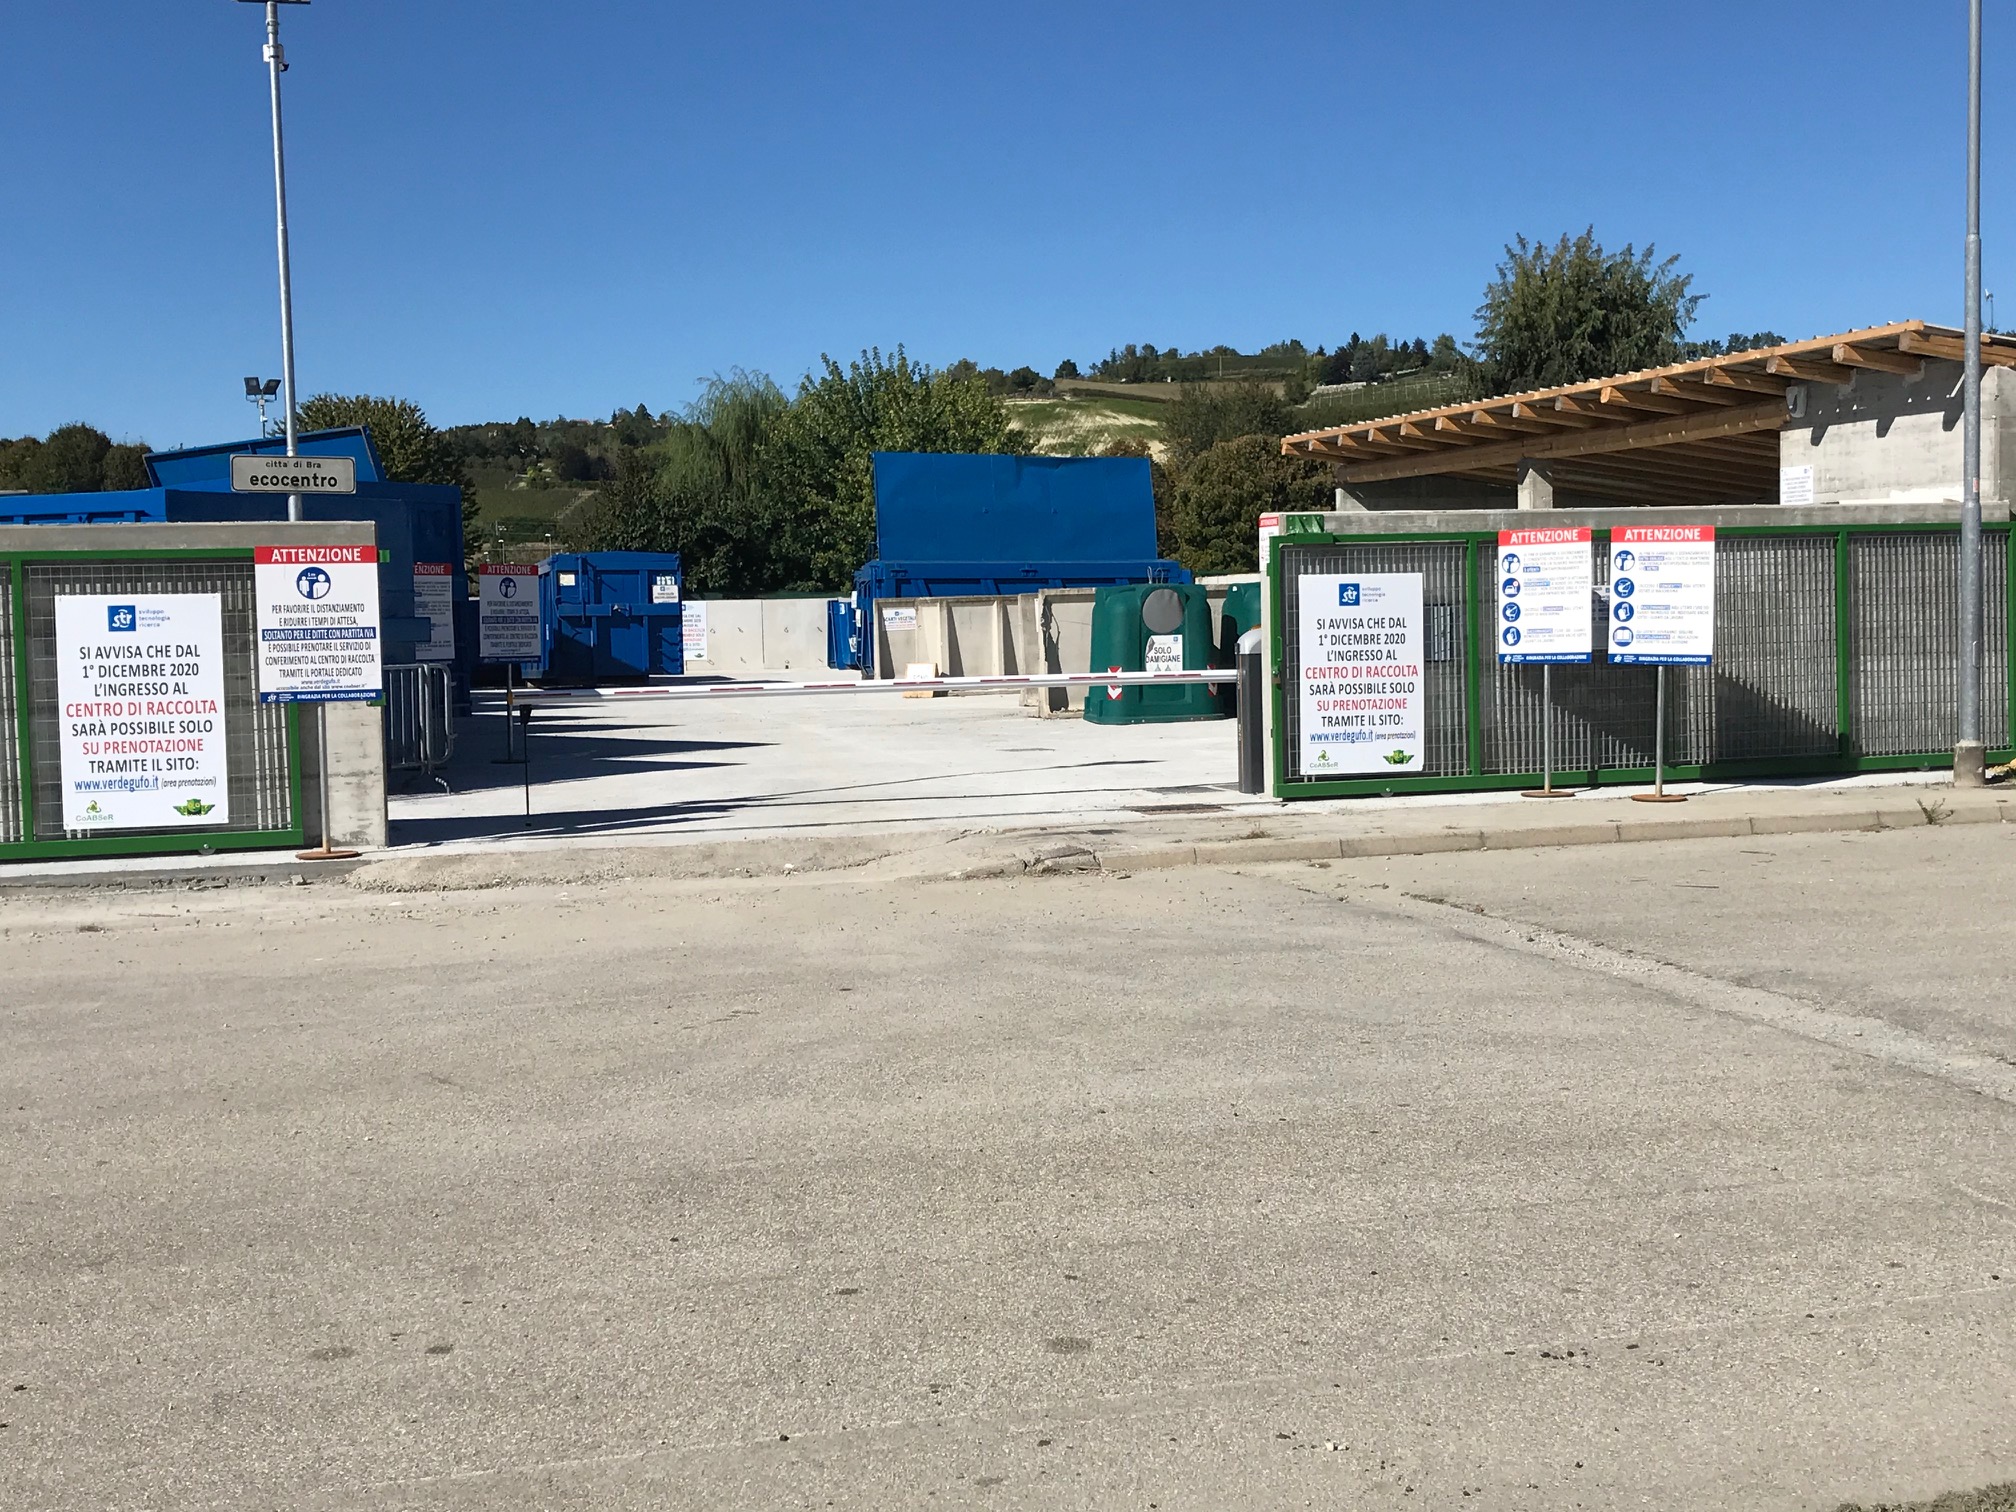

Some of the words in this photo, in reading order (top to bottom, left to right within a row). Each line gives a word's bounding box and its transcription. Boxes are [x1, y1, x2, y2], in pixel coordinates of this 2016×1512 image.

[250, 473, 337, 487] ecocentro
[1510, 529, 1578, 544] ATTENZIONE
[1625, 528, 1700, 540] ATTENZIONE
[271, 548, 361, 562] ATTENZIONE
[415, 566, 444, 574] ENZIONE
[487, 566, 531, 574] ATTENZIONE
[272, 604, 282, 614] PER
[283, 604, 309, 614] FAVORIRE
[311, 604, 316, 613] IL
[317, 603, 364, 613] DISTANZIAMENTO
[280, 618, 282, 626] E
[284, 617, 307, 626] RIDURRE
[312, 617, 329, 626] TEMPI
[330, 617, 336, 625] DI
[337, 616, 358, 626] ATTESA,
[1317, 619, 1325, 630] SI
[1328, 618, 1364, 629] AVVISA
[1367, 618, 1385, 629] CHE
[1388, 617, 1407, 628] DAL
[264, 630, 292, 640] SOLTANTO
[294, 630, 304, 639] PER
[305, 630, 311, 639] LE
[312, 629, 327, 639] DITTE
[329, 629, 340, 638] CON
[341, 629, 363, 638] PARTITA
[364, 628, 374, 638] IVA
[1331, 634, 1381, 645] DICEMBRE
[1384, 633, 1405, 644] 2020
[80, 646, 90, 659] SI
[95, 646, 142, 659] AVVISA
[146, 645, 171, 658] CHE
[175, 644, 200, 658] DAL
[272, 643, 299, 652] POSSIBILE
[301, 642, 332, 651] PRENOTARE
[334, 642, 338, 651] IL
[340, 642, 364, 651] SERVIZIO
[365, 642, 371, 650] DI
[1154, 646, 1171, 654] SOLO
[265, 656, 308, 665] CONFERIMENTO
[310, 656, 316, 664] AL
[318, 655, 339, 664] CENTRO
[341, 655, 347, 663] DI
[348, 654, 375, 663] RACCOLTA
[1386, 650, 1397, 660] AL
[98, 664, 166, 678] DICEMBRE
[170, 663, 199, 676] 2020
[279, 669, 303, 678] TRAMITE
[305, 669, 310, 677] IL
[311, 668, 334, 677] PORTALE
[336, 667, 362, 676] DEDICATO
[1305, 667, 1348, 679] CENTRO
[1352, 666, 1362, 678] DI
[1366, 665, 1418, 677] RACCOLTA
[173, 682, 188, 695] AL
[1310, 682, 1335, 695] SARÀ
[1339, 682, 1386, 694] POSSIBILE
[1390, 682, 1414, 693] SOLO
[66, 702, 123, 717] CENTRO
[128, 702, 141, 716] DI
[147, 700, 217, 715] RACCOLTA
[1317, 700, 1329, 711] SU
[1333, 698, 1407, 711] PRENOTAZIONE
[1321, 715, 1365, 727] TRAMITE
[1368, 715, 1376, 726] IL
[1379, 714, 1403, 725] SITO:
[72, 720, 106, 736] SARÀ
[111, 721, 175, 735] POSSIBILE
[179, 720, 213, 733] SOLO
[1310, 729, 1373, 743] www.verdegufo.it
[83, 742, 99, 755] SU
[104, 739, 203, 754] PRENOTAZIONE
[89, 759, 147, 773] TRAMITE
[152, 759, 162, 771] IL
[166, 758, 199, 771] SITO:
[74, 775, 158, 792] www.verdegufo.it
[161, 778, 176, 789] (area
[178, 776, 216, 789] prenotazioni)
